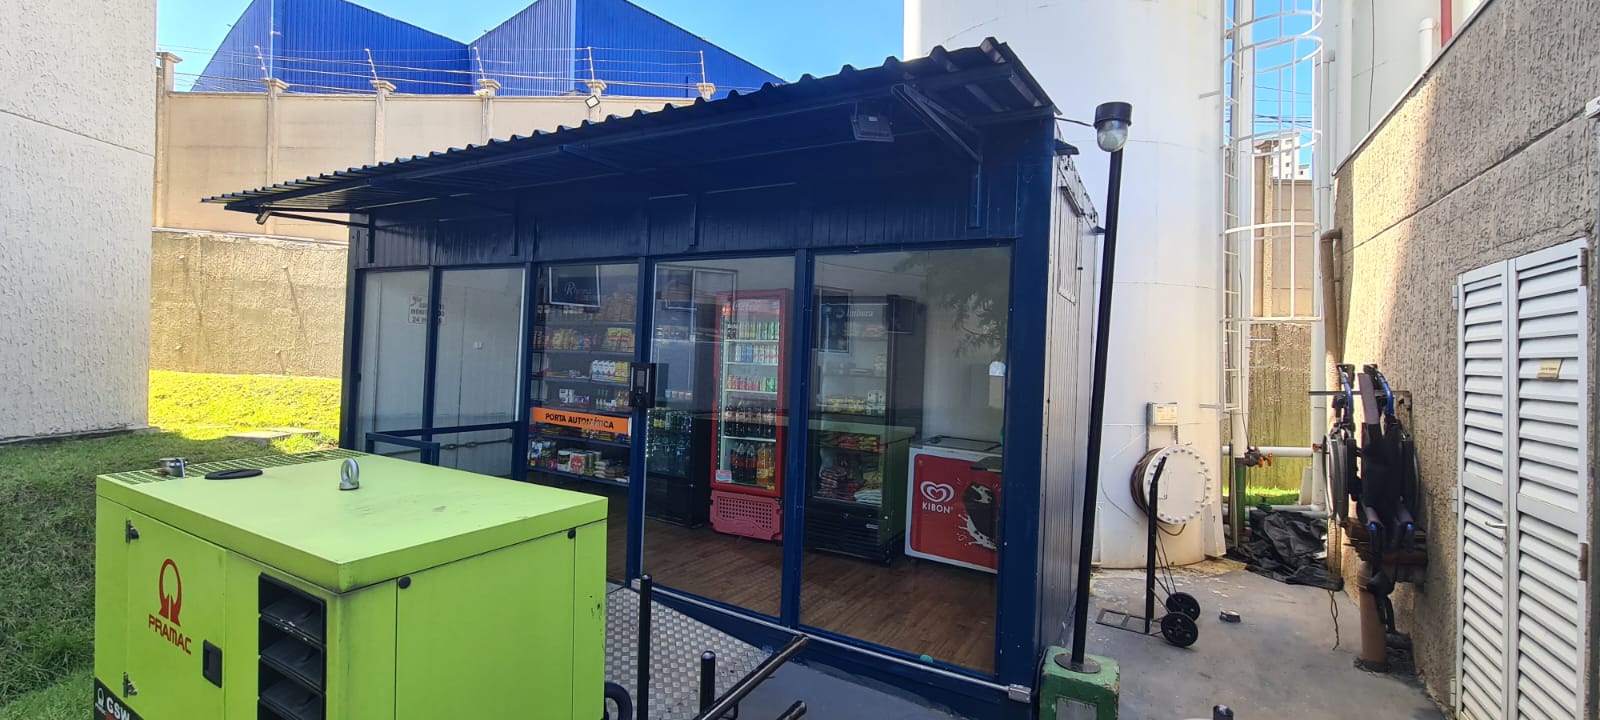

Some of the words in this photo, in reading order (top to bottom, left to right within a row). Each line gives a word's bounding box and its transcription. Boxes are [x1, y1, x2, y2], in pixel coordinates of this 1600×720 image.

[545, 413, 566, 423] PORTA
[922, 501, 951, 514] KIBON
[148, 613, 192, 655] PRAMAC
